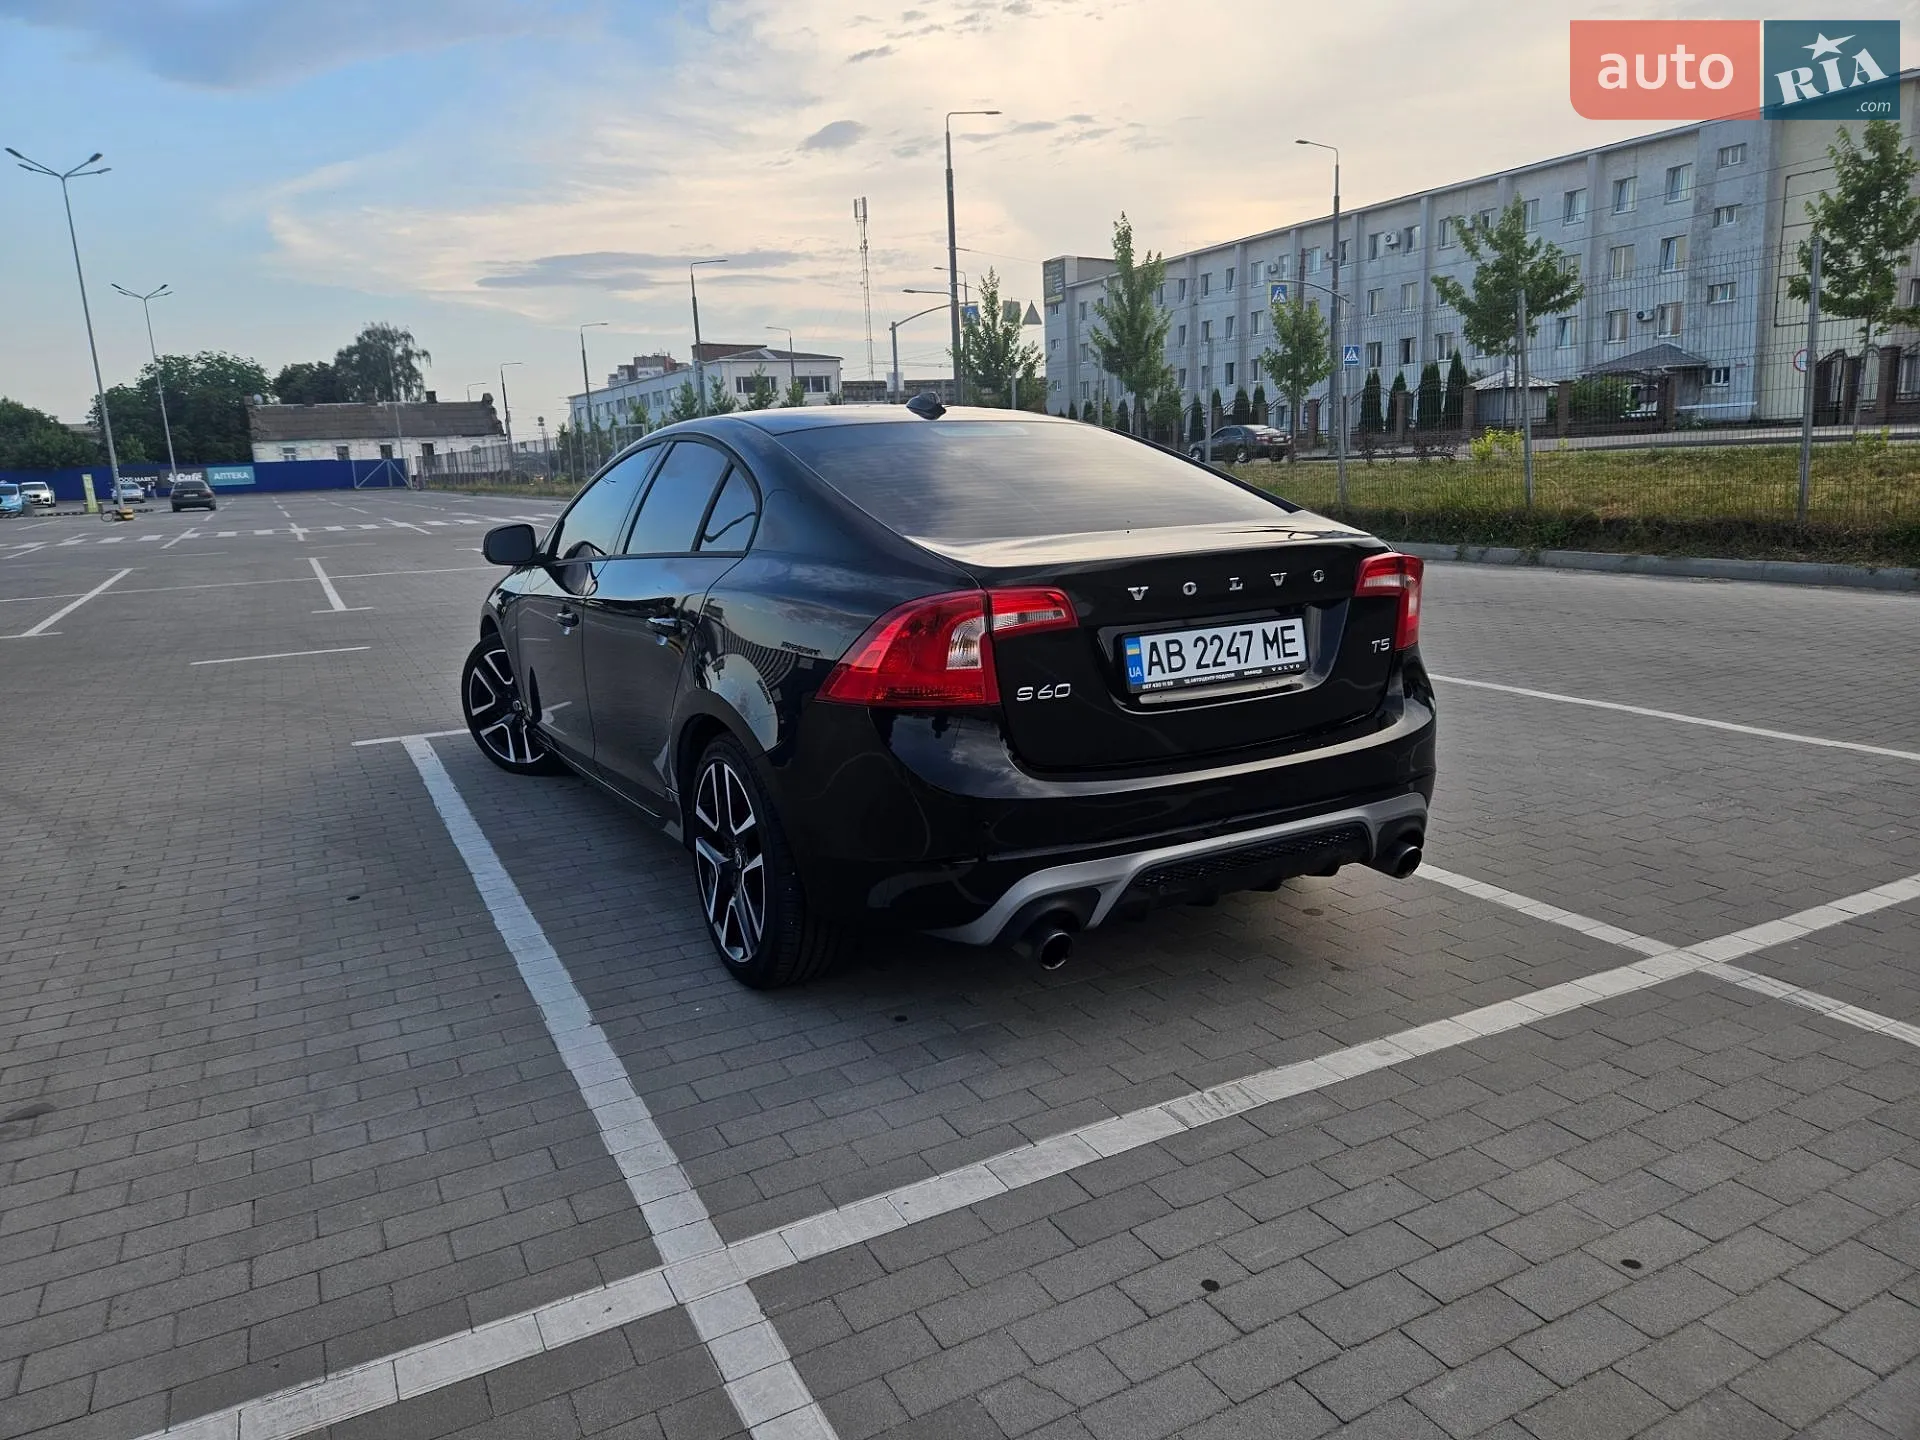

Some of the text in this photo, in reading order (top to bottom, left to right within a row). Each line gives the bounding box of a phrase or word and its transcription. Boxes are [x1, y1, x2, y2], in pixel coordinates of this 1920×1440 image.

[213, 471, 250, 481] АПТЕКА
[1127, 569, 1325, 601] VOLVO
[1147, 624, 1299, 676] AB 2247 ME
[1371, 637, 1390, 654] T5
[1129, 666, 1143, 678] UA
[1272, 664, 1300, 672] VOLVO
[1016, 683, 1071, 702] S60
